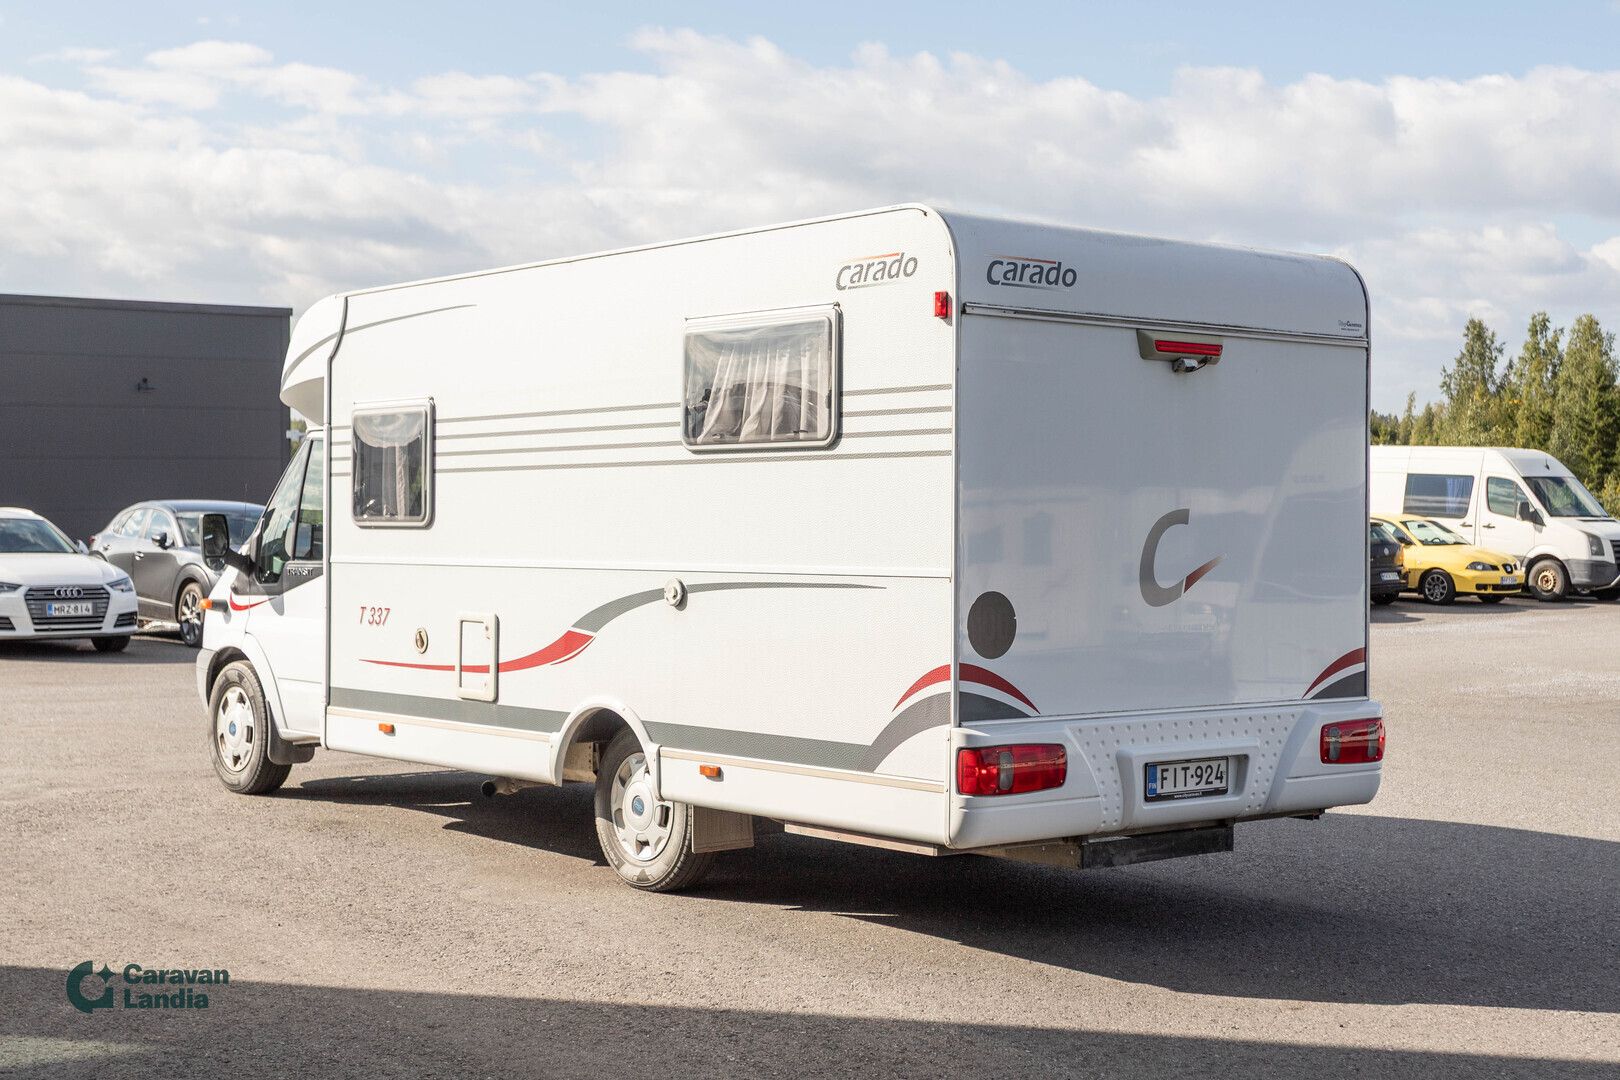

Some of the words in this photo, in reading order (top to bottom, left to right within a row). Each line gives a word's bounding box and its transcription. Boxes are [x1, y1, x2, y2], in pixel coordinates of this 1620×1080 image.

[836, 252, 918, 291] Carado
[986, 260, 1077, 288] Carado
[360, 606, 367, 624] T
[368, 606, 391, 626] 337
[1160, 764, 1224, 789] FIT-924
